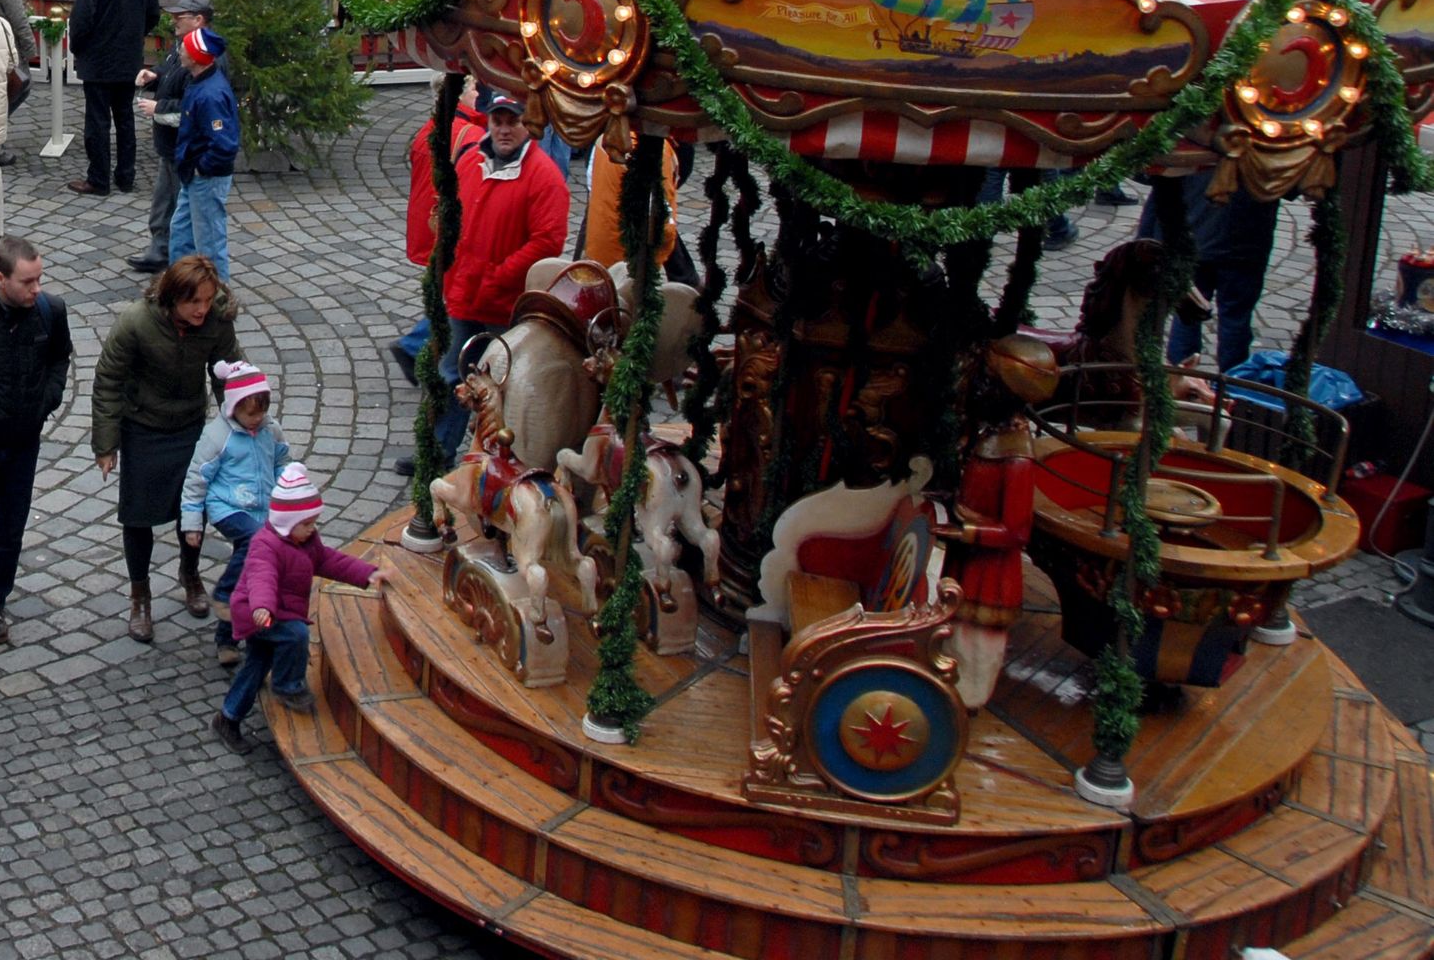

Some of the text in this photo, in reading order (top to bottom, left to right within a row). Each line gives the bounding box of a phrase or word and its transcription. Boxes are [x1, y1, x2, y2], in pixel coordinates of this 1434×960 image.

[777, 5, 858, 23] Pleasure for All
